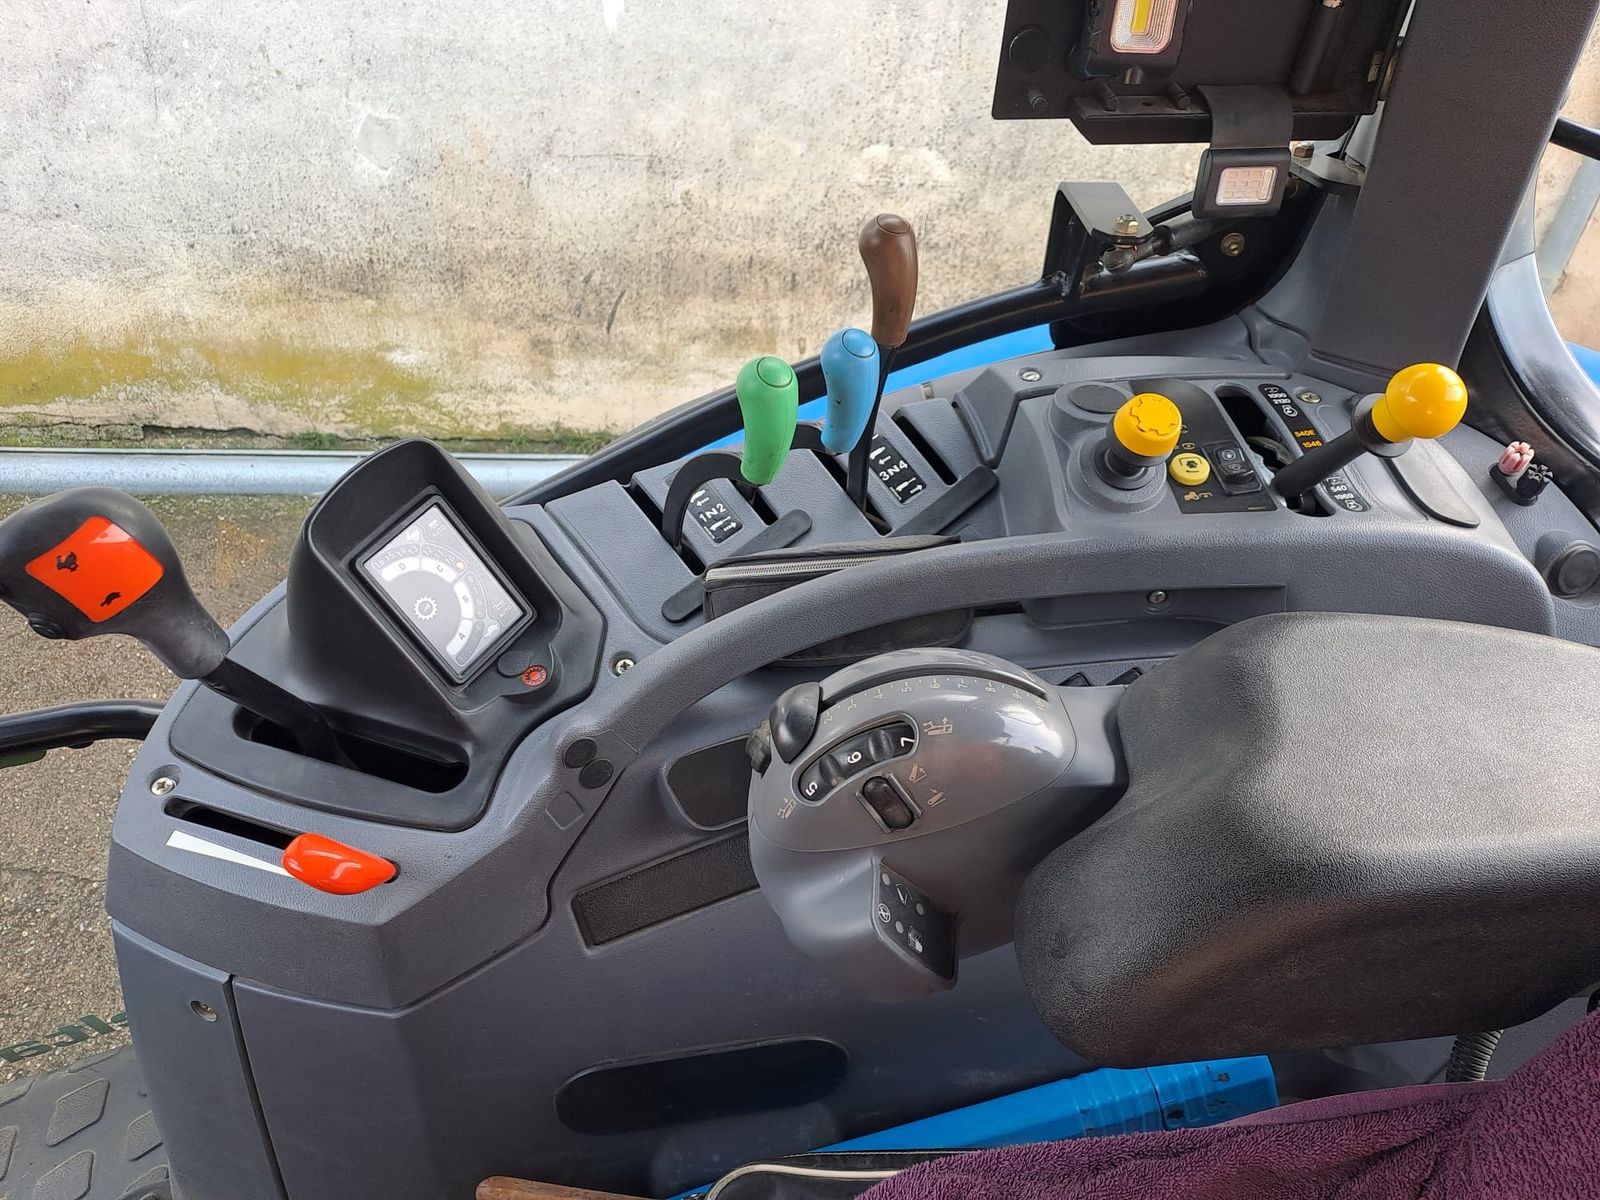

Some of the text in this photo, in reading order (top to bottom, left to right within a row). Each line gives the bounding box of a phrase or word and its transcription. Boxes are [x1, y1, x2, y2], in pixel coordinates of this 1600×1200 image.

[1294, 429, 1316, 438] 540E
[1302, 440, 1322, 449] 1546
[1330, 485, 1348, 493] 540
[432, 524, 446, 537] AUTO
[805, 782, 818, 797] 5
[900, 736, 915, 748] 7
